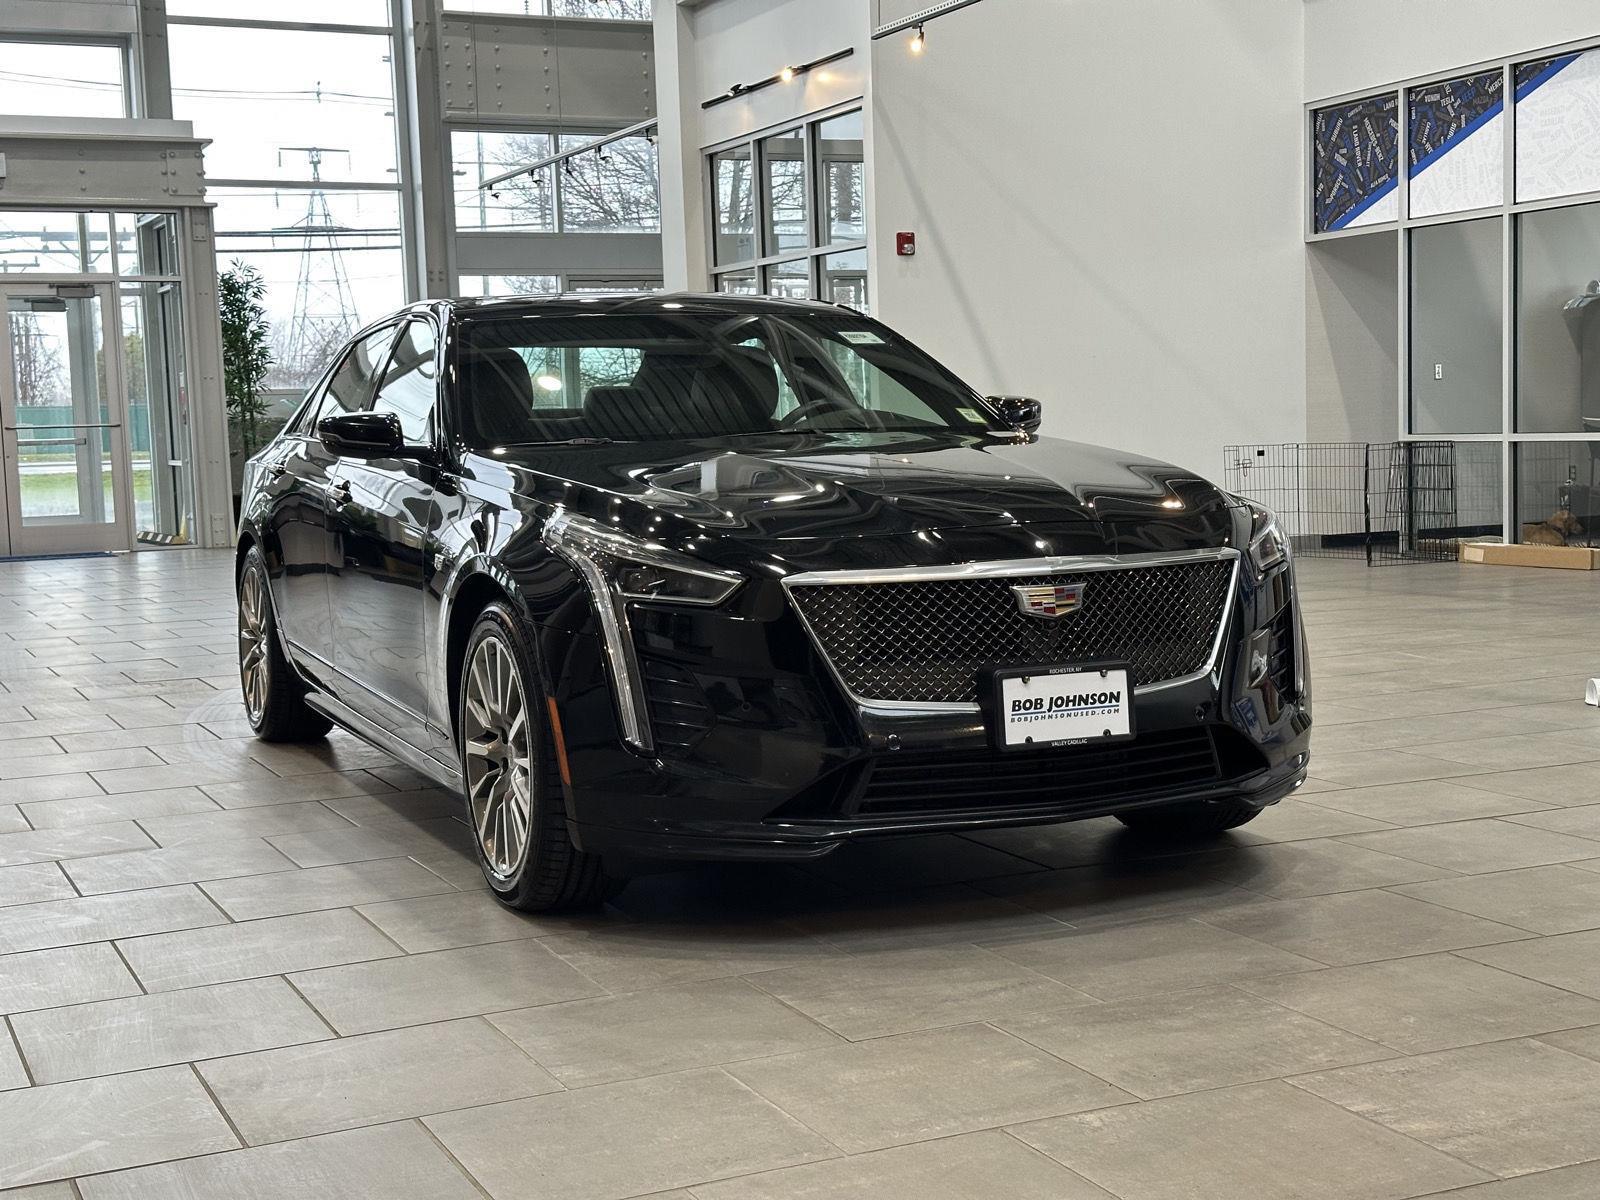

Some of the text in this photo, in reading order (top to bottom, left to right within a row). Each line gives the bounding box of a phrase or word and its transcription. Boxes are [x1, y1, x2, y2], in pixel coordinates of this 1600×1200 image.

[1441, 95, 1455, 107] TESLA
[1330, 117, 1343, 142] SUBARU
[1012, 691, 1121, 713] BOB JOHNSON
[1011, 708, 1120, 723] BOBJOHNSONUSED.COM
[1067, 738, 1088, 746] CADILLAC
